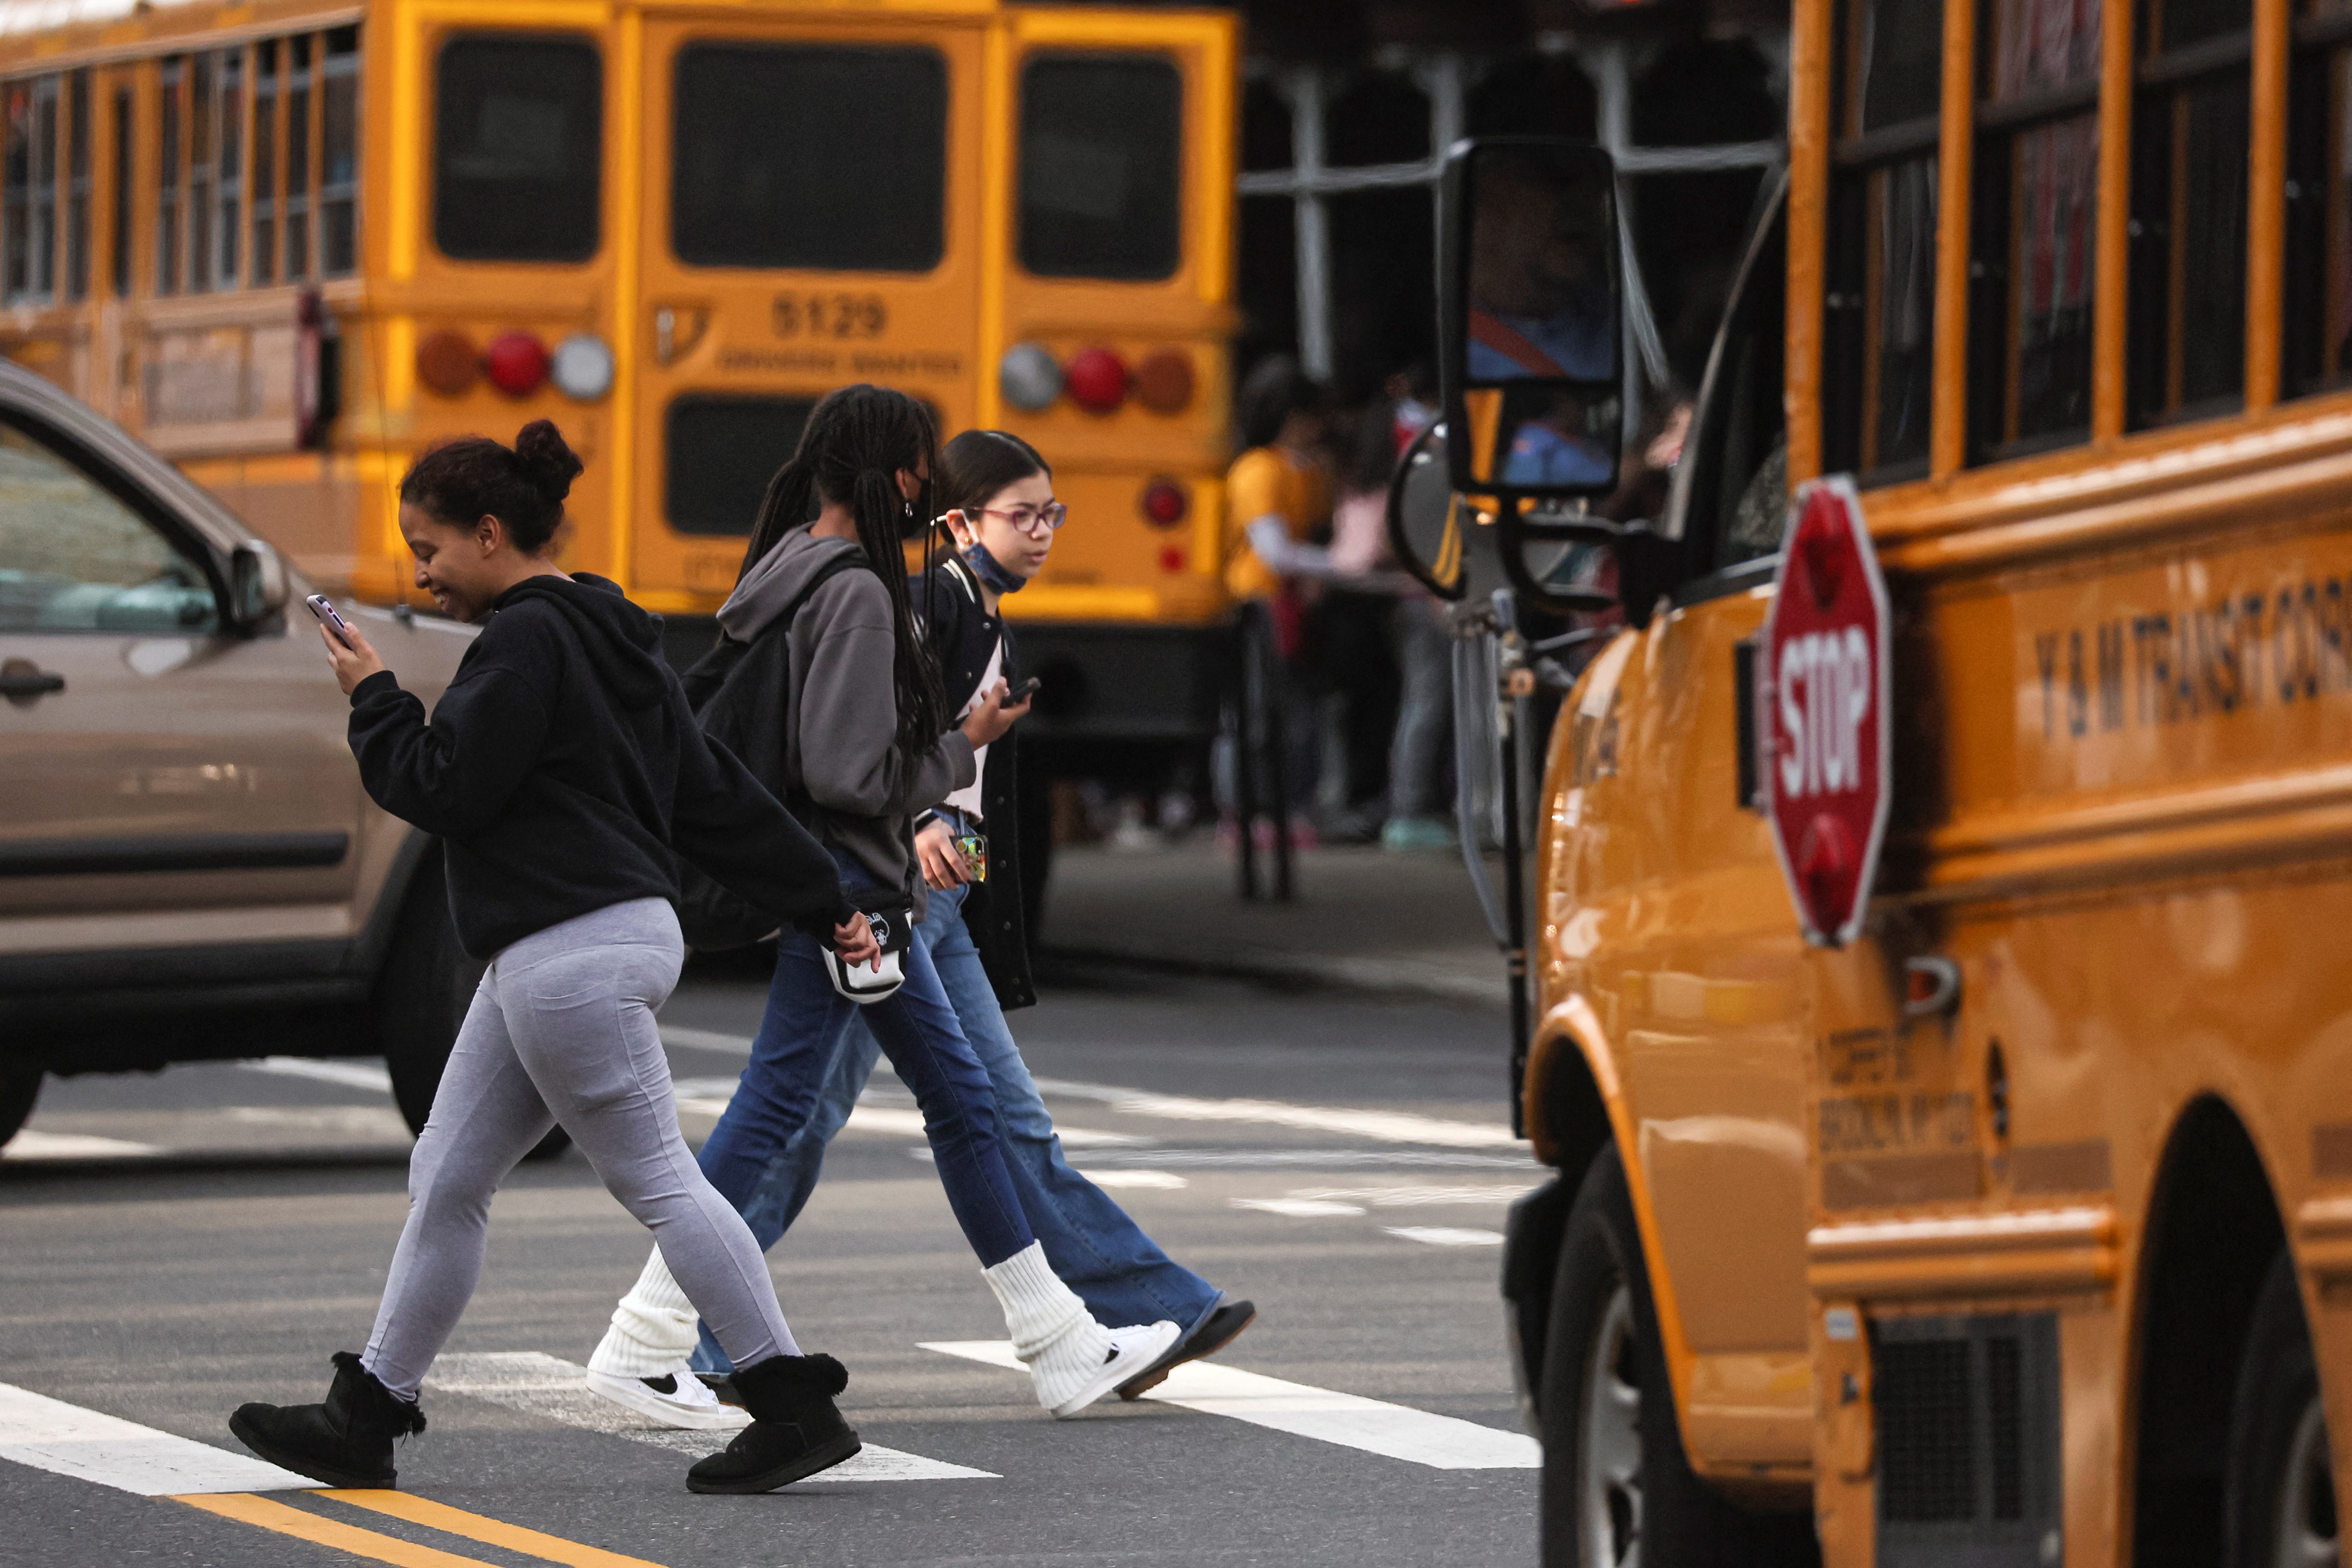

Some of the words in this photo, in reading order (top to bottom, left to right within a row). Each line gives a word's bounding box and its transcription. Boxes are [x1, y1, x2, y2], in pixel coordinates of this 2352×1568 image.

[772, 292, 886, 337] 5129
[1779, 626, 1870, 797] STOP
[2132, 589, 2264, 724] TRANSIT
[2277, 573, 2352, 705] COR
